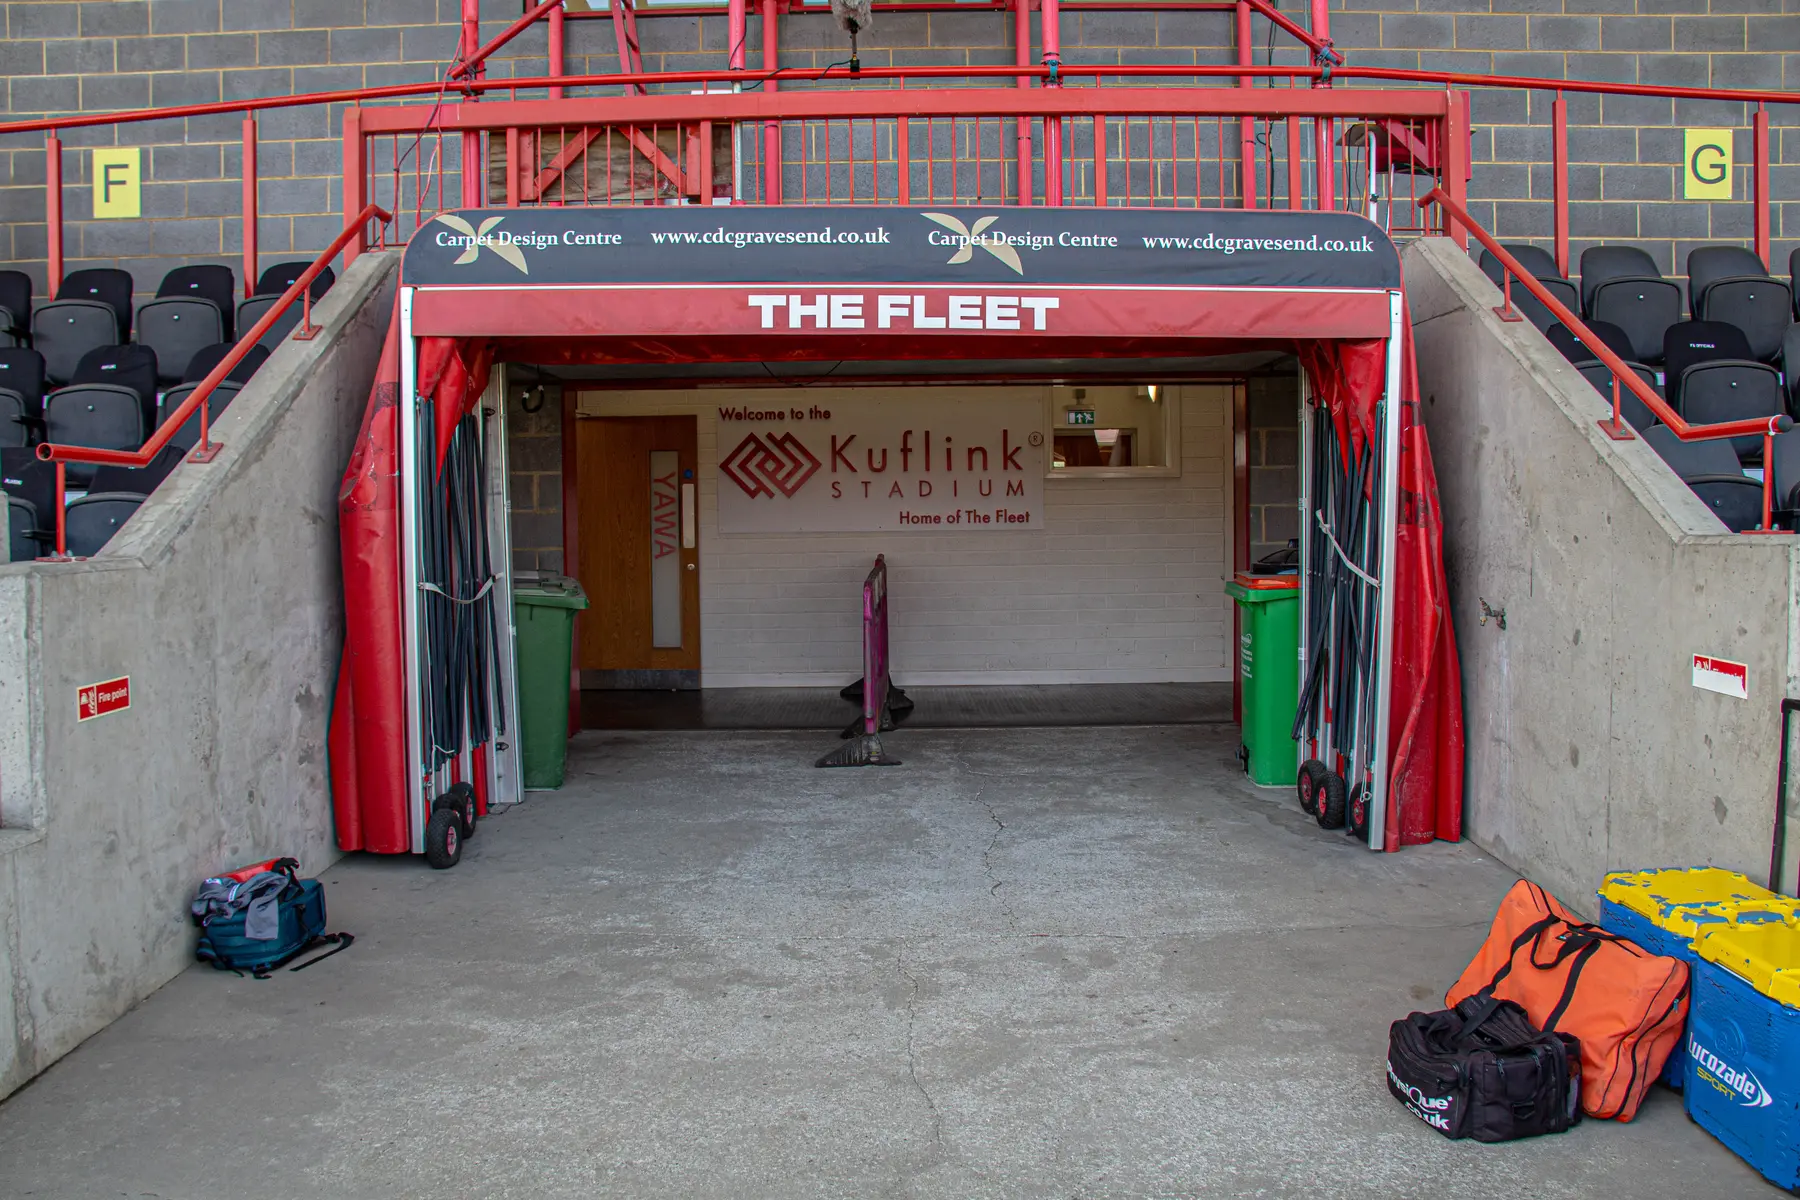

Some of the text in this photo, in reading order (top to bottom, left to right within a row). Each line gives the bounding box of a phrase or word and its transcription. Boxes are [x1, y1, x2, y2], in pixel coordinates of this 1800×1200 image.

[1691, 144, 1727, 185] G
[104, 164, 129, 203] F
[435, 229, 622, 251] Carpet Design Centre
[650, 226, 890, 249] www.cdcgravesend.co.uk
[928, 229, 1118, 251] Carpet Design Centre
[1142, 232, 1374, 255] www.cdcgravesend.co.uk
[747, 294, 1060, 331] THE FLEET
[719, 404, 831, 422] Welcome to the
[830, 428, 1024, 474] Kuflink
[830, 479, 1026, 499] STADIUM
[899, 508, 1031, 525] Home of The Fleet
[98, 687, 127, 703] Fire point
[1688, 1031, 1757, 1101] Lucozade
[1696, 1065, 1737, 1101] SPORT
